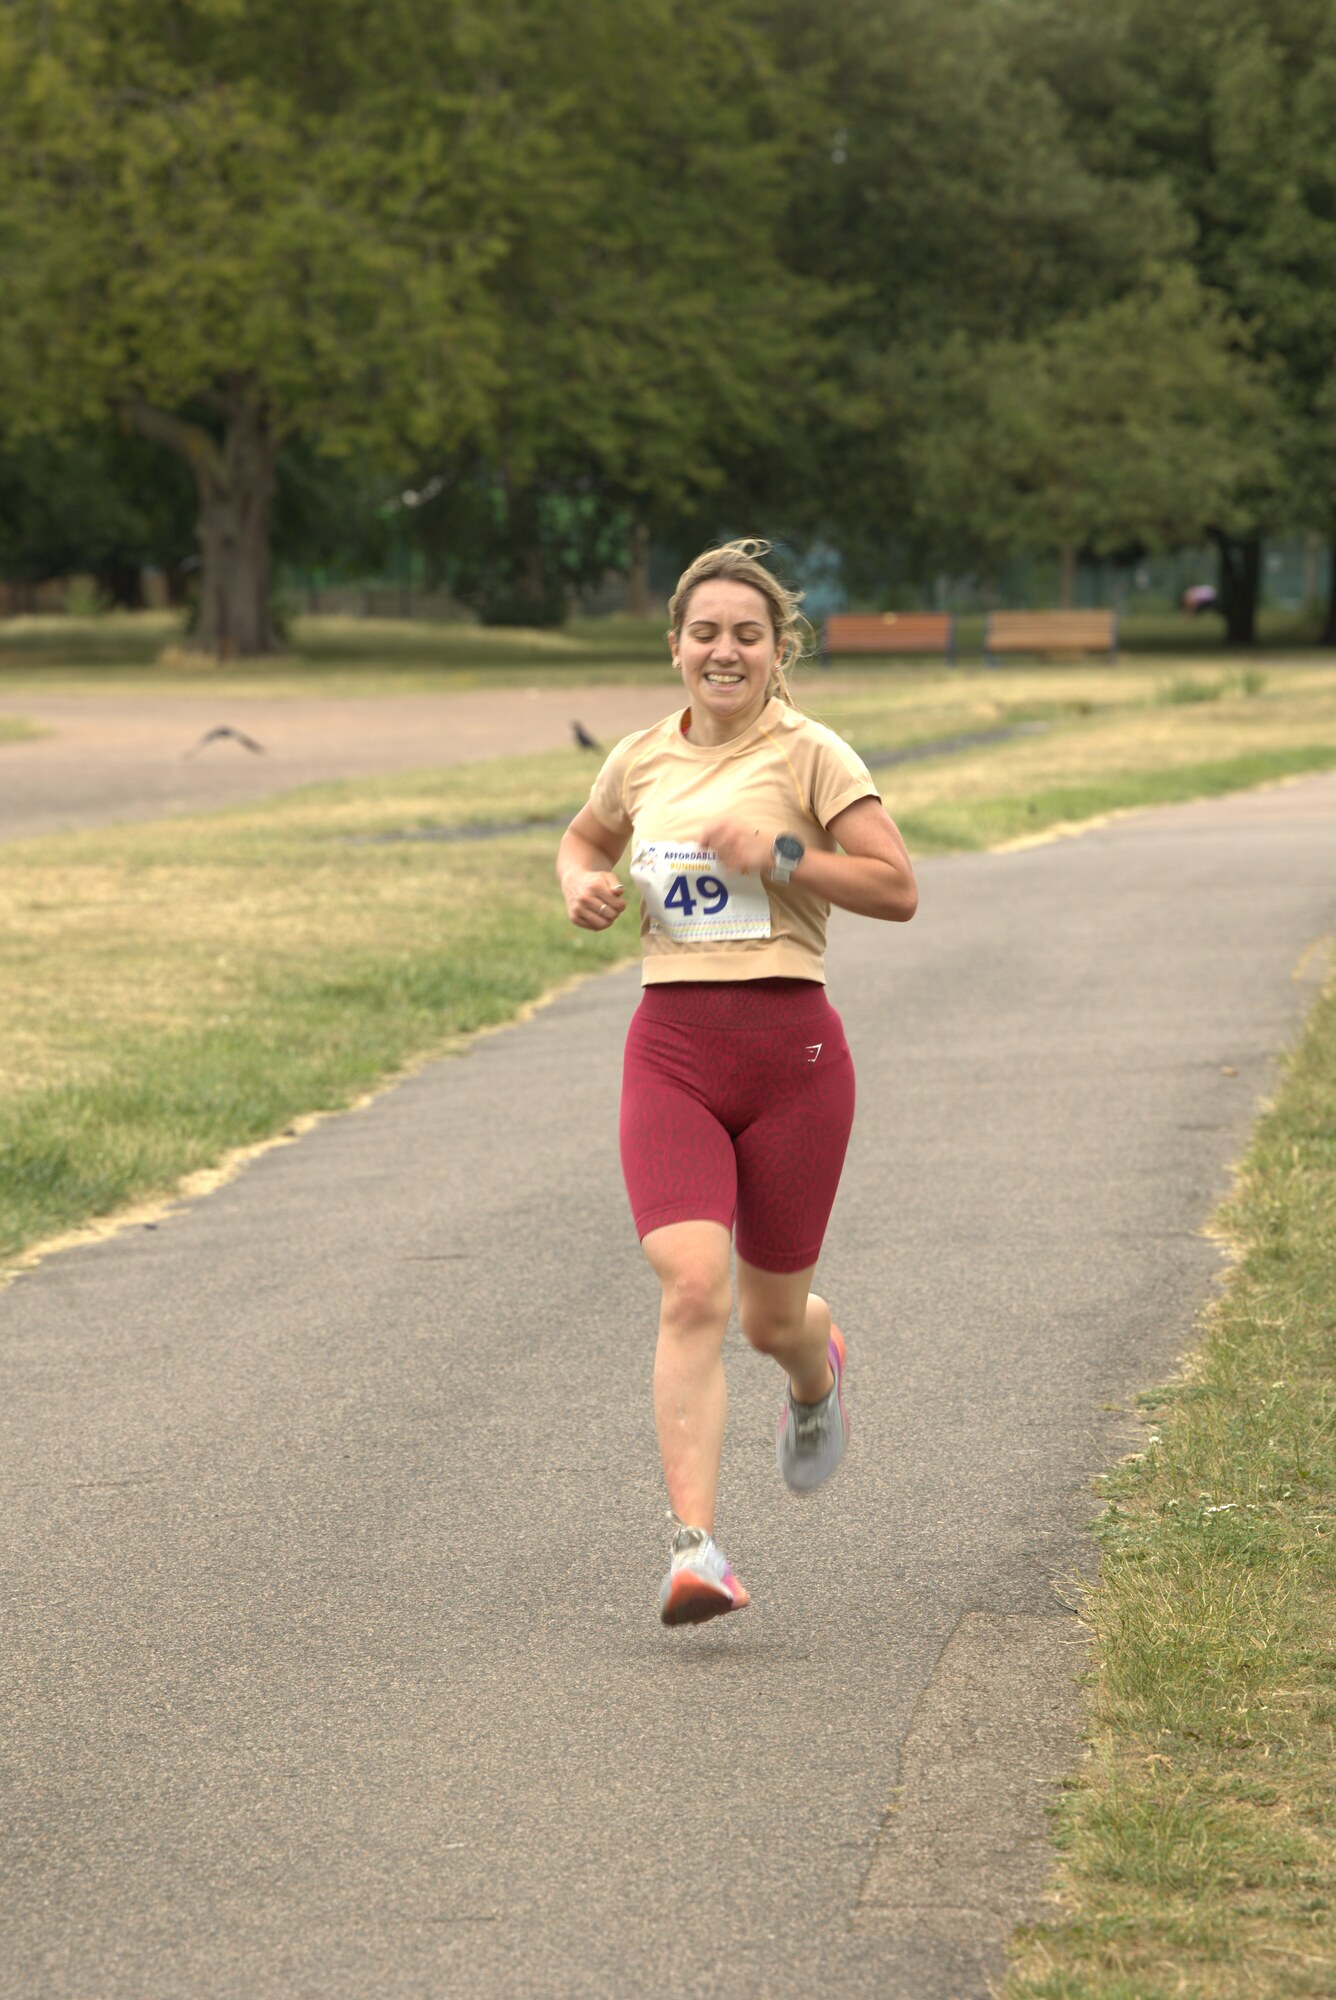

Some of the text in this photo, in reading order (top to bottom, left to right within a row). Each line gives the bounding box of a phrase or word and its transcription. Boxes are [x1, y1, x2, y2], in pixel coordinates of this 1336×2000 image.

[664, 851, 717, 861] AFFORDABLE
[670, 862, 711, 872] RUNNING
[664, 874, 729, 917] 49
